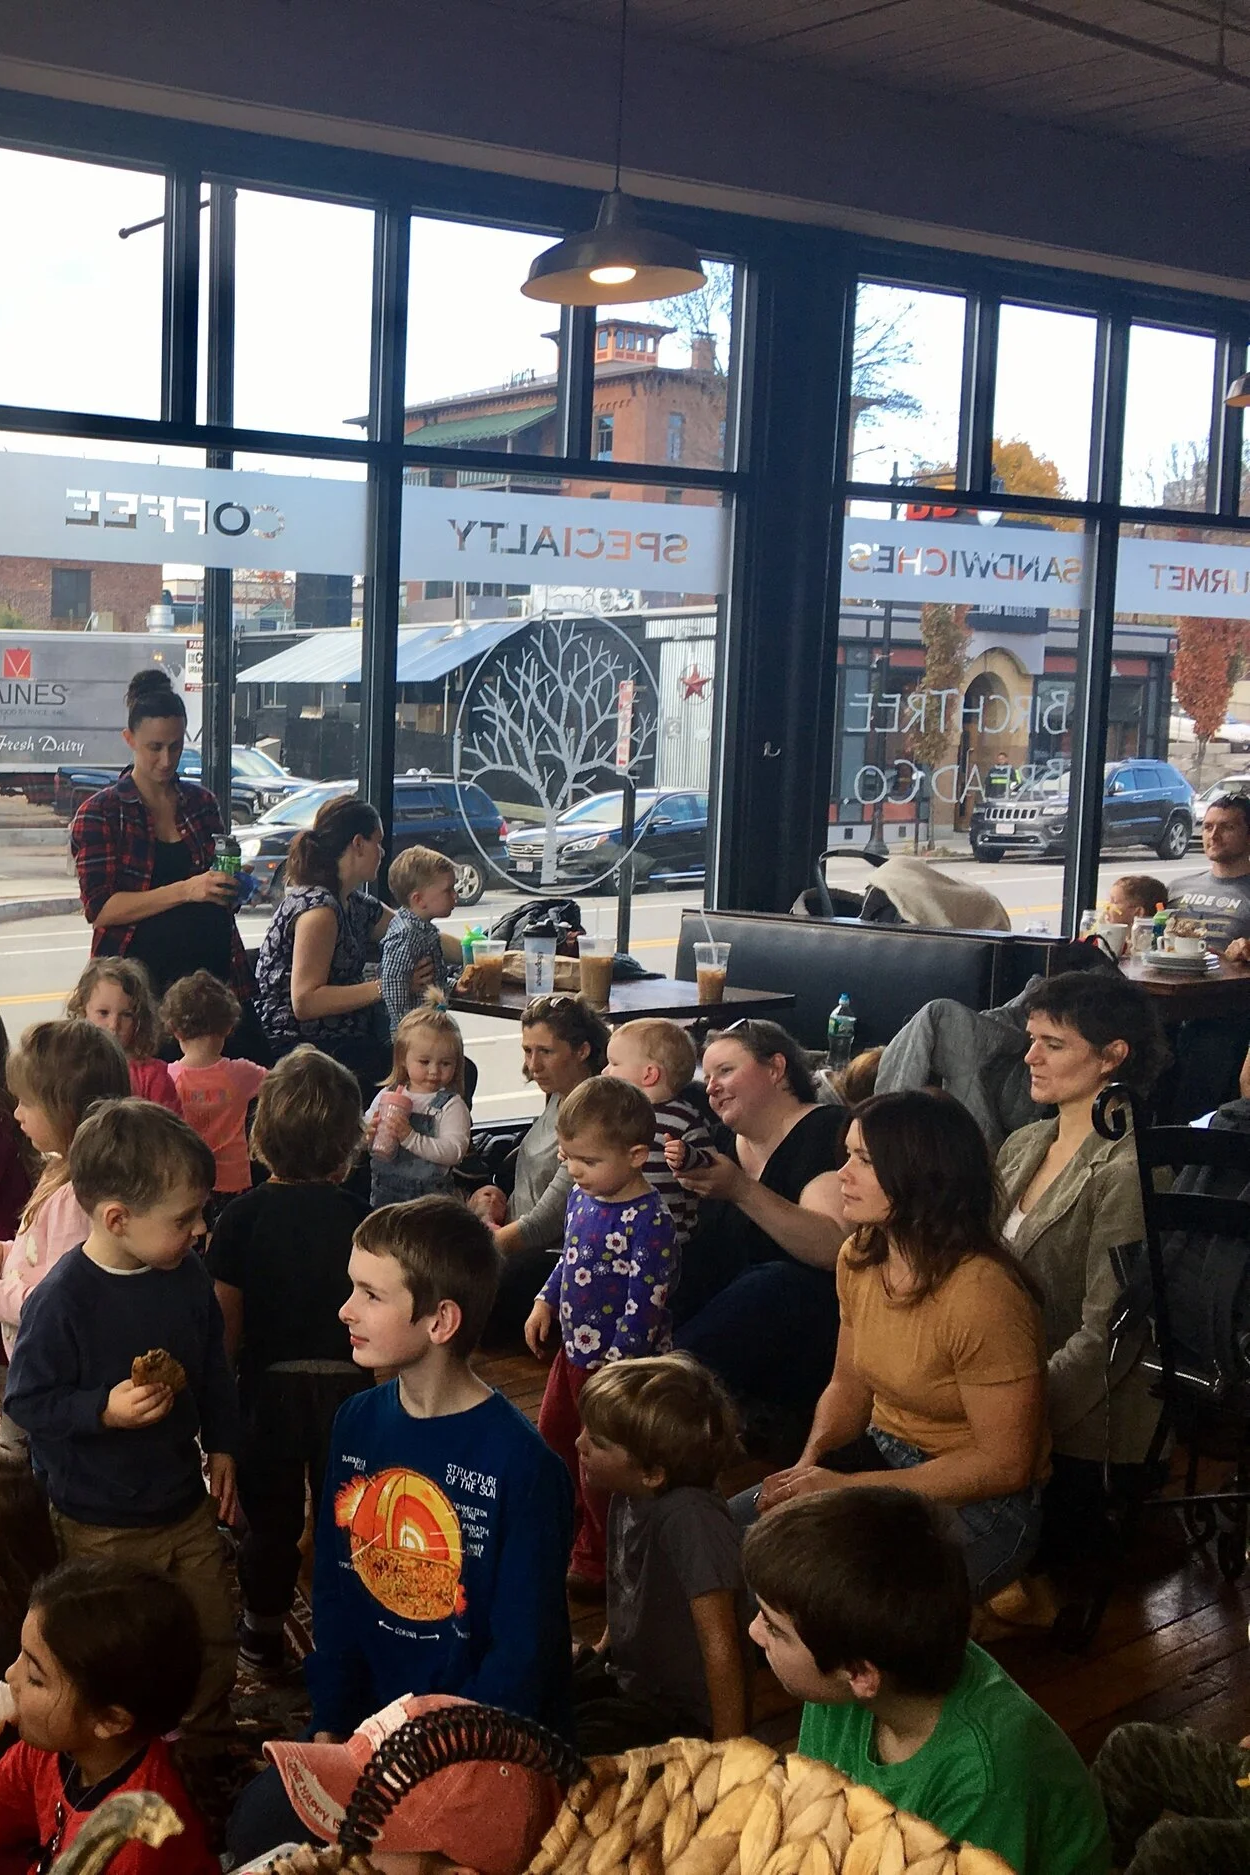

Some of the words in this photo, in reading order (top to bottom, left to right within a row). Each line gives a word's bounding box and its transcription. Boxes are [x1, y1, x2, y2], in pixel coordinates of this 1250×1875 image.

[39, 735, 85, 757] Dairy
[1180, 893, 1216, 906] RIDE
[1216, 897, 1242, 909] ON
[446, 1474, 457, 1485] OF
[460, 1477, 476, 1494] THE
[479, 1485, 497, 1499] SUN
[299, 1785, 330, 1823] HAPPY
